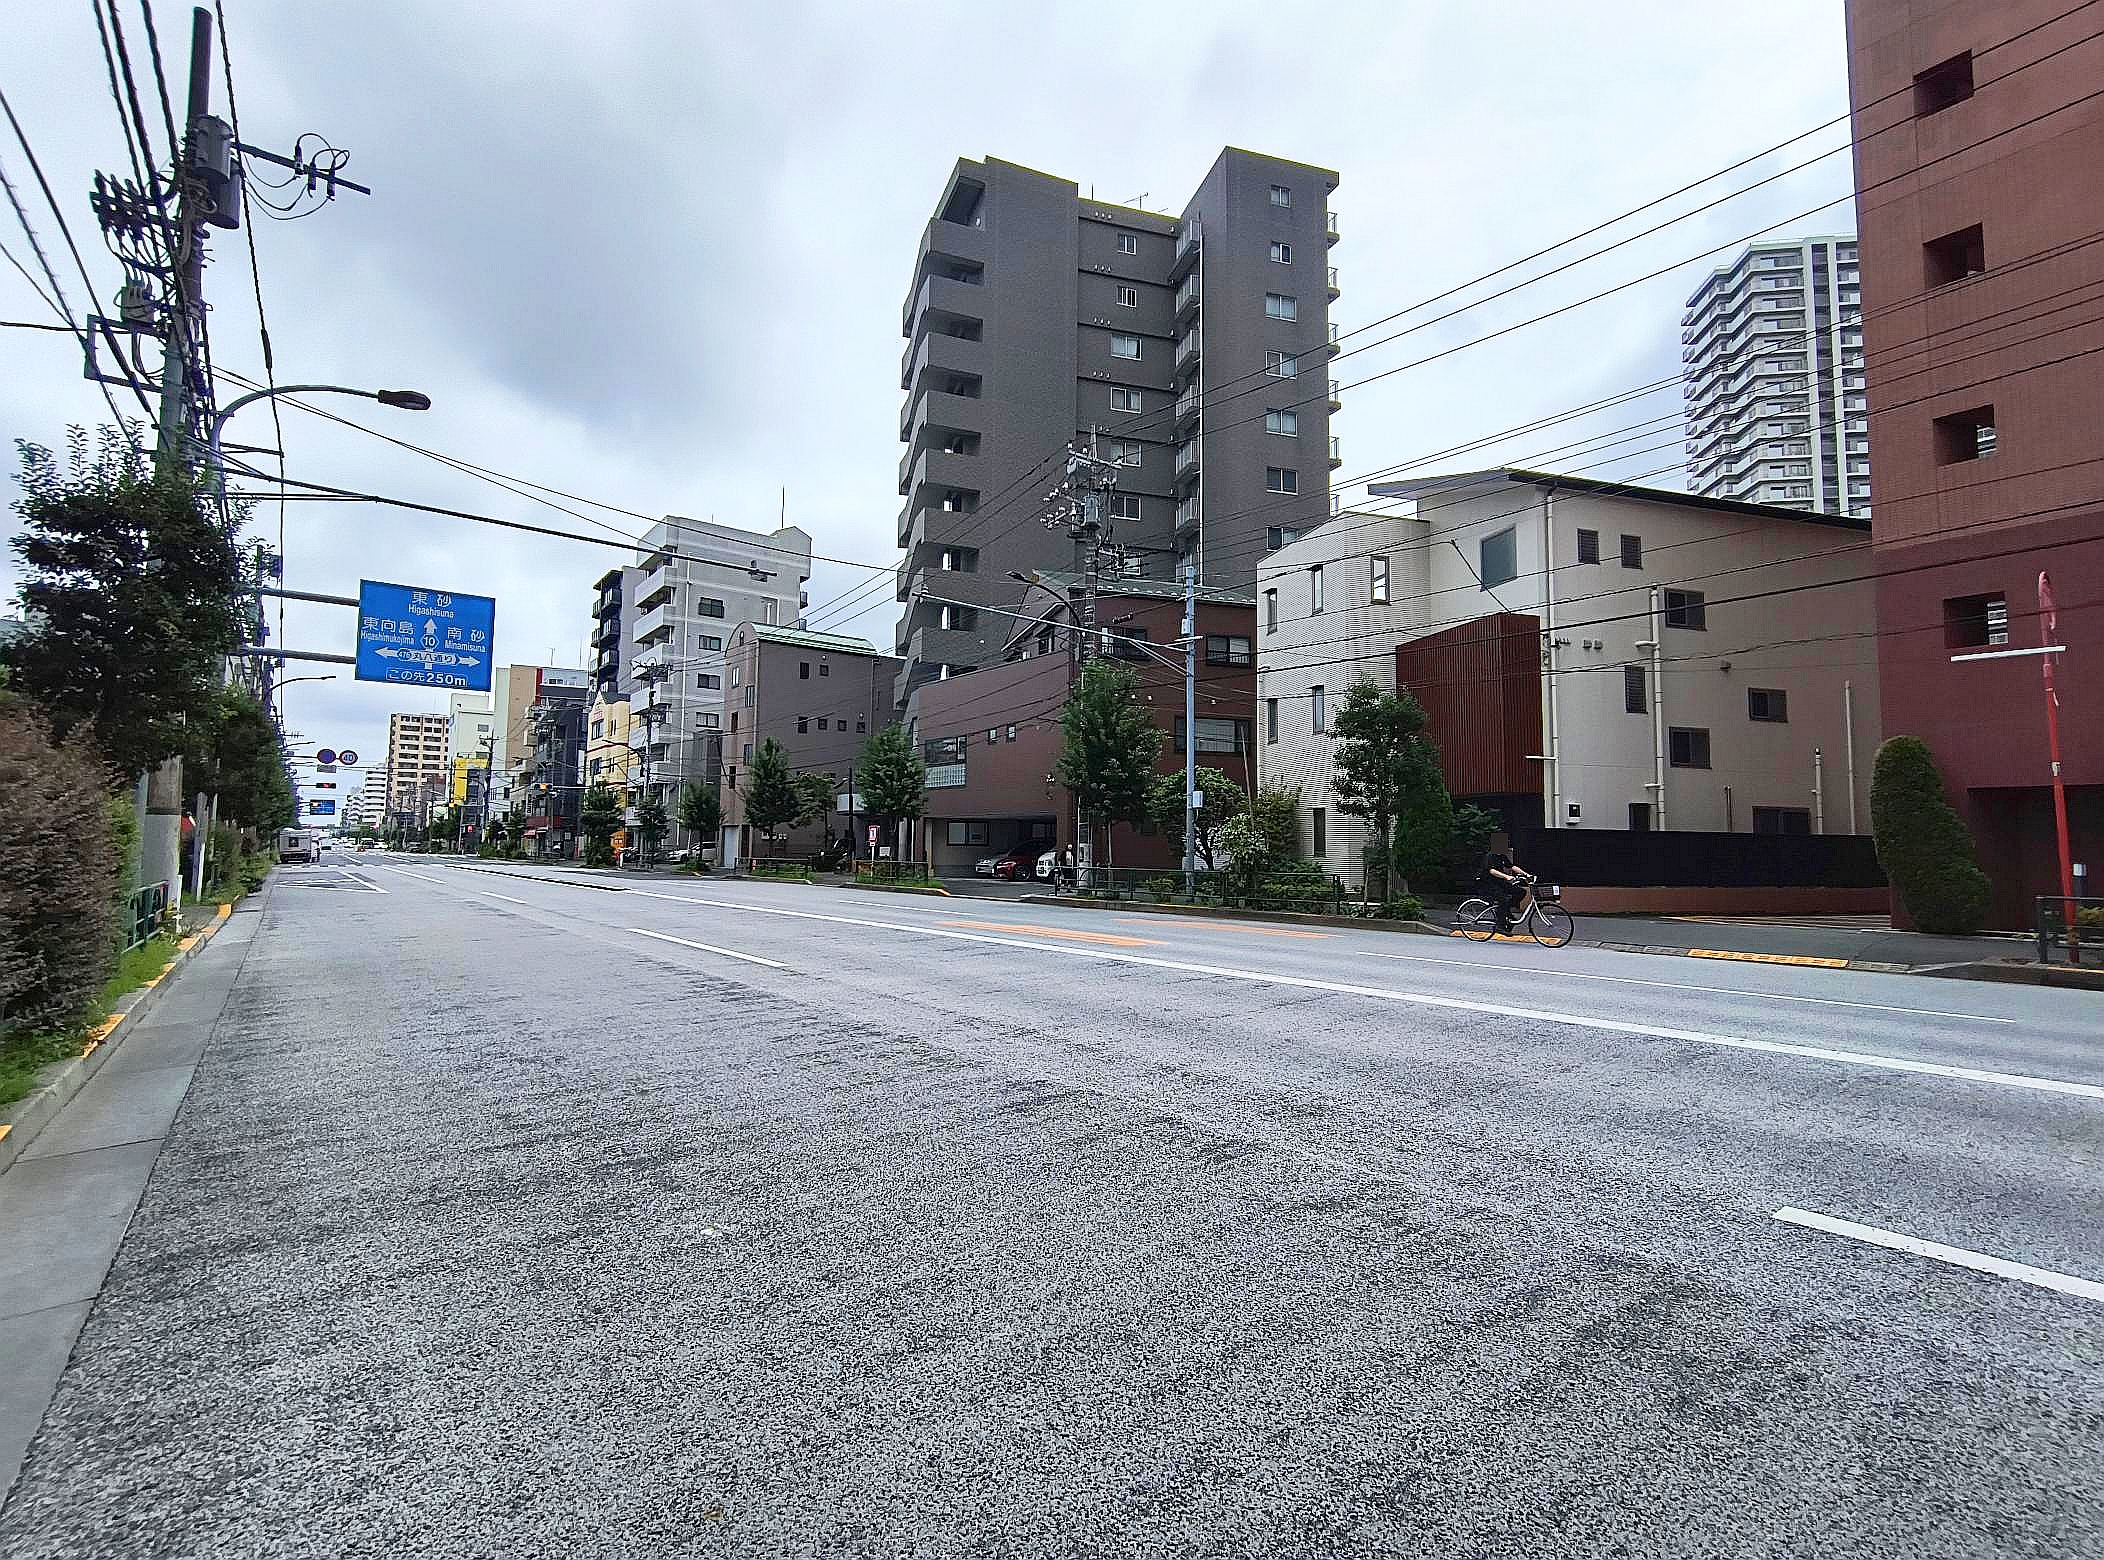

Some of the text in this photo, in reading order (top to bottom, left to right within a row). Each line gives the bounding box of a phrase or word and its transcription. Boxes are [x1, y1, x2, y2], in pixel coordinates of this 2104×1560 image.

[408, 603, 455, 618] Higashisuna
[362, 616, 415, 635] 東向島
[360, 630, 415, 645] Higashimukojima
[423, 635, 436, 646] 10
[444, 639, 486, 653] Minamisuna
[343, 753, 354, 762] 40
